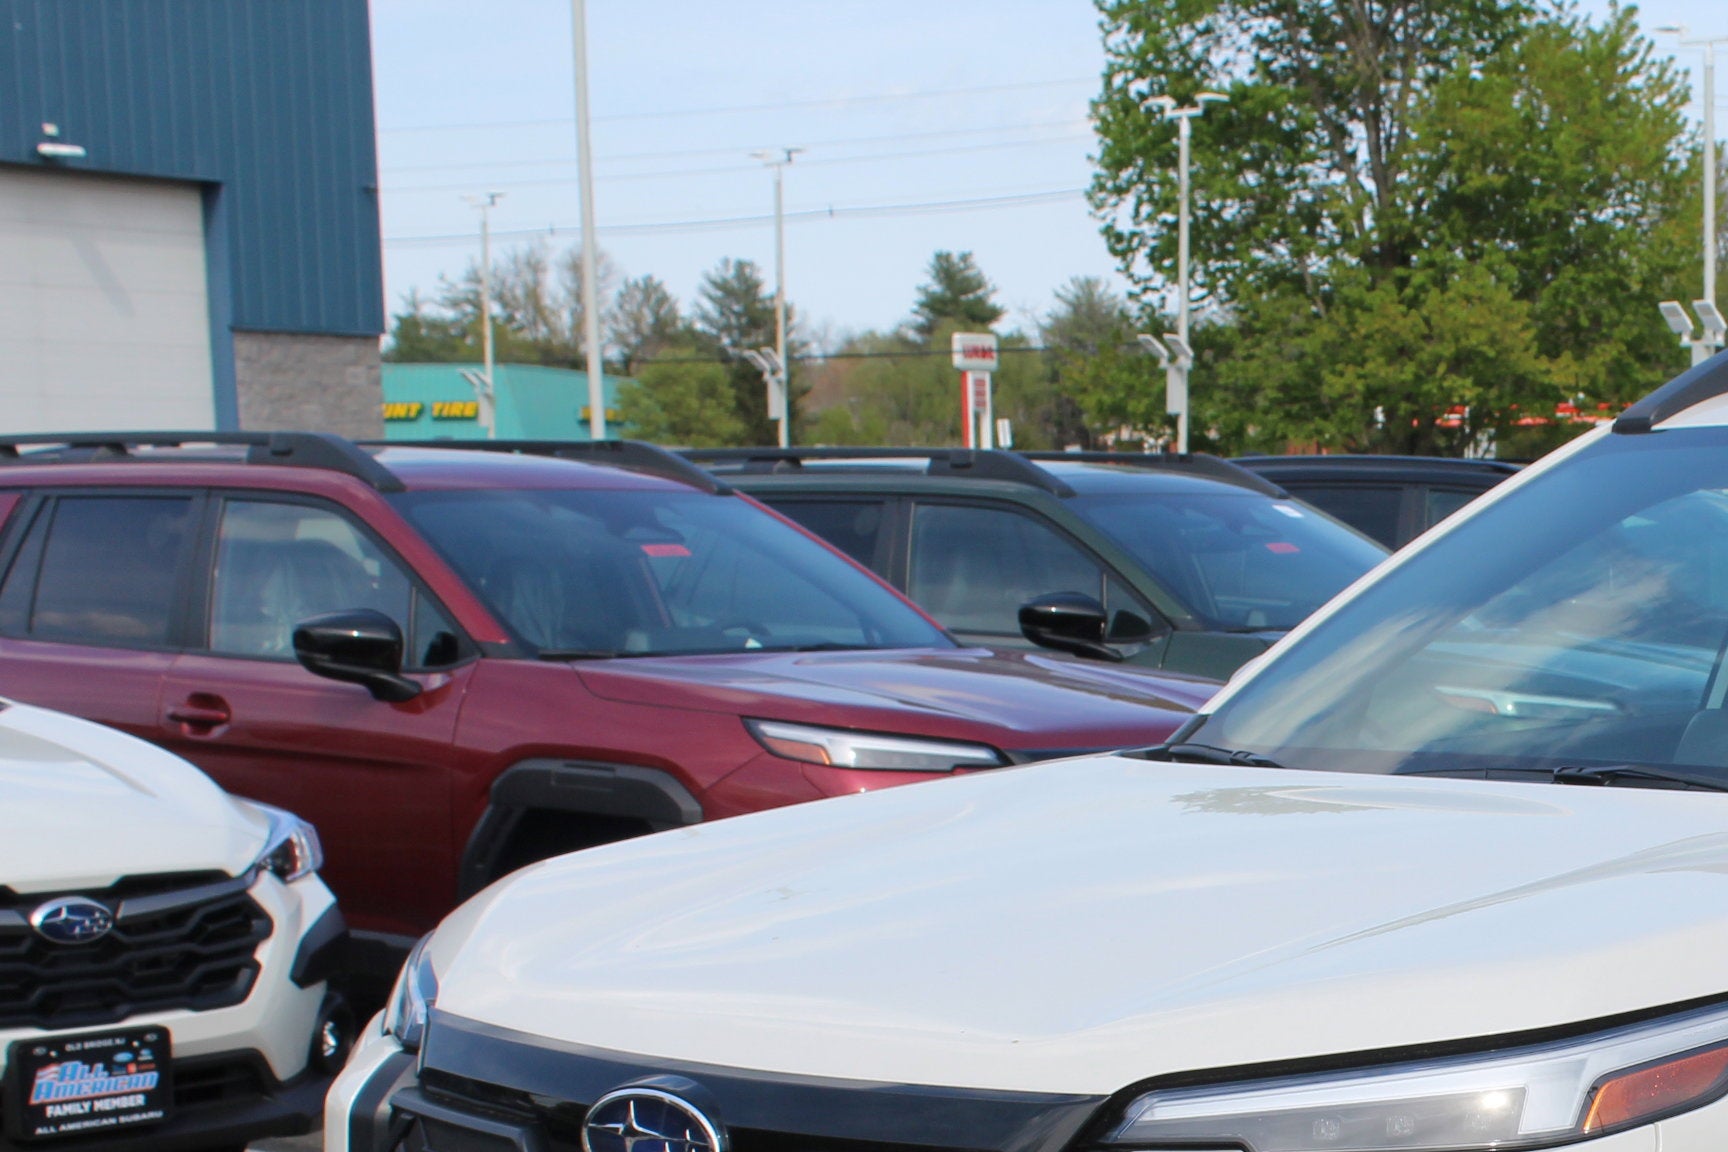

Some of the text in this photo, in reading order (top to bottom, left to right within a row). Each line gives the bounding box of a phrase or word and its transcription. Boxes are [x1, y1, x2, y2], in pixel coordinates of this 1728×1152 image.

[432, 401, 478, 418] TIRE
[46, 1094, 146, 1118] FAMILY MEMBER
[34, 1110, 164, 1135] ALL AMERICAN SUBARU
